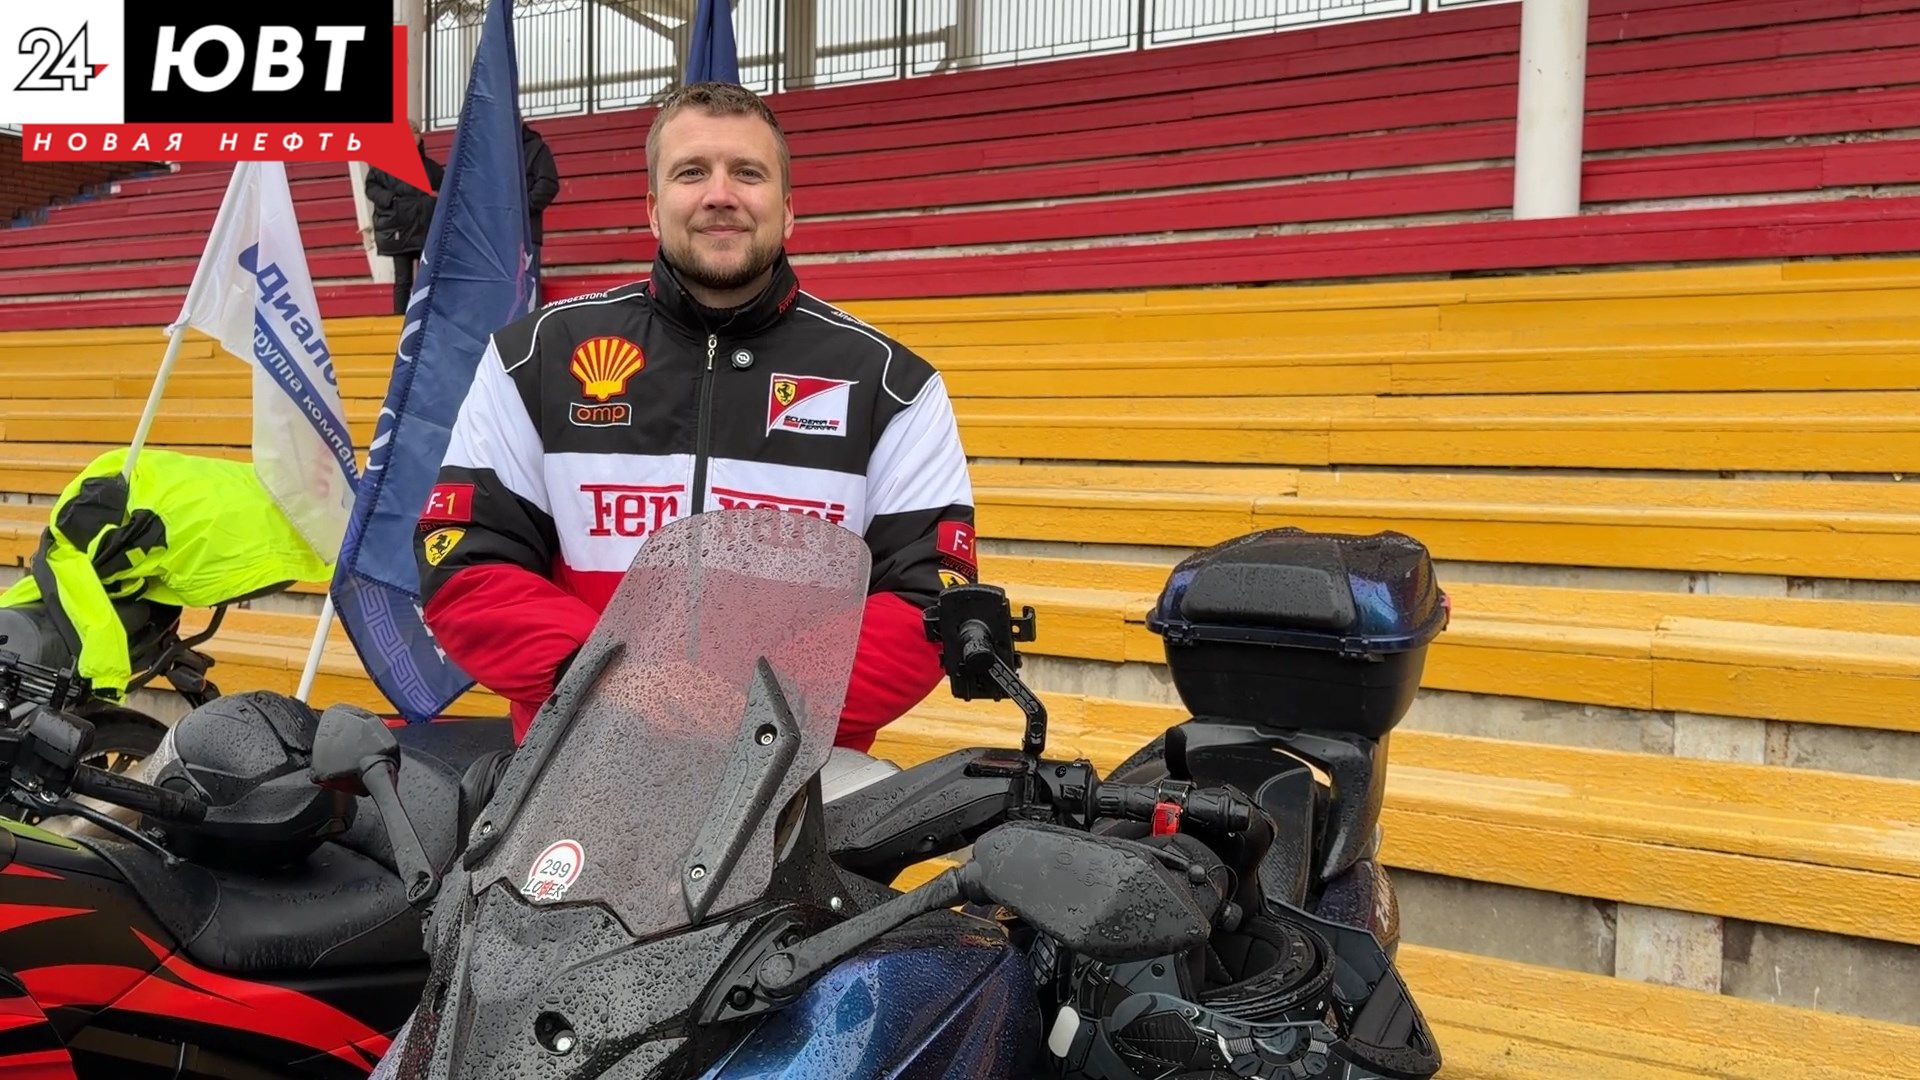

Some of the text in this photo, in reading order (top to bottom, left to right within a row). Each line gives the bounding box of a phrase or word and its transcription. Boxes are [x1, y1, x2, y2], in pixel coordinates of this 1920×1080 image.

[256, 262, 340, 397] Диало
[576, 405, 626, 423] omp
[426, 491, 457, 515] F-1
[540, 859, 571, 877] 299
